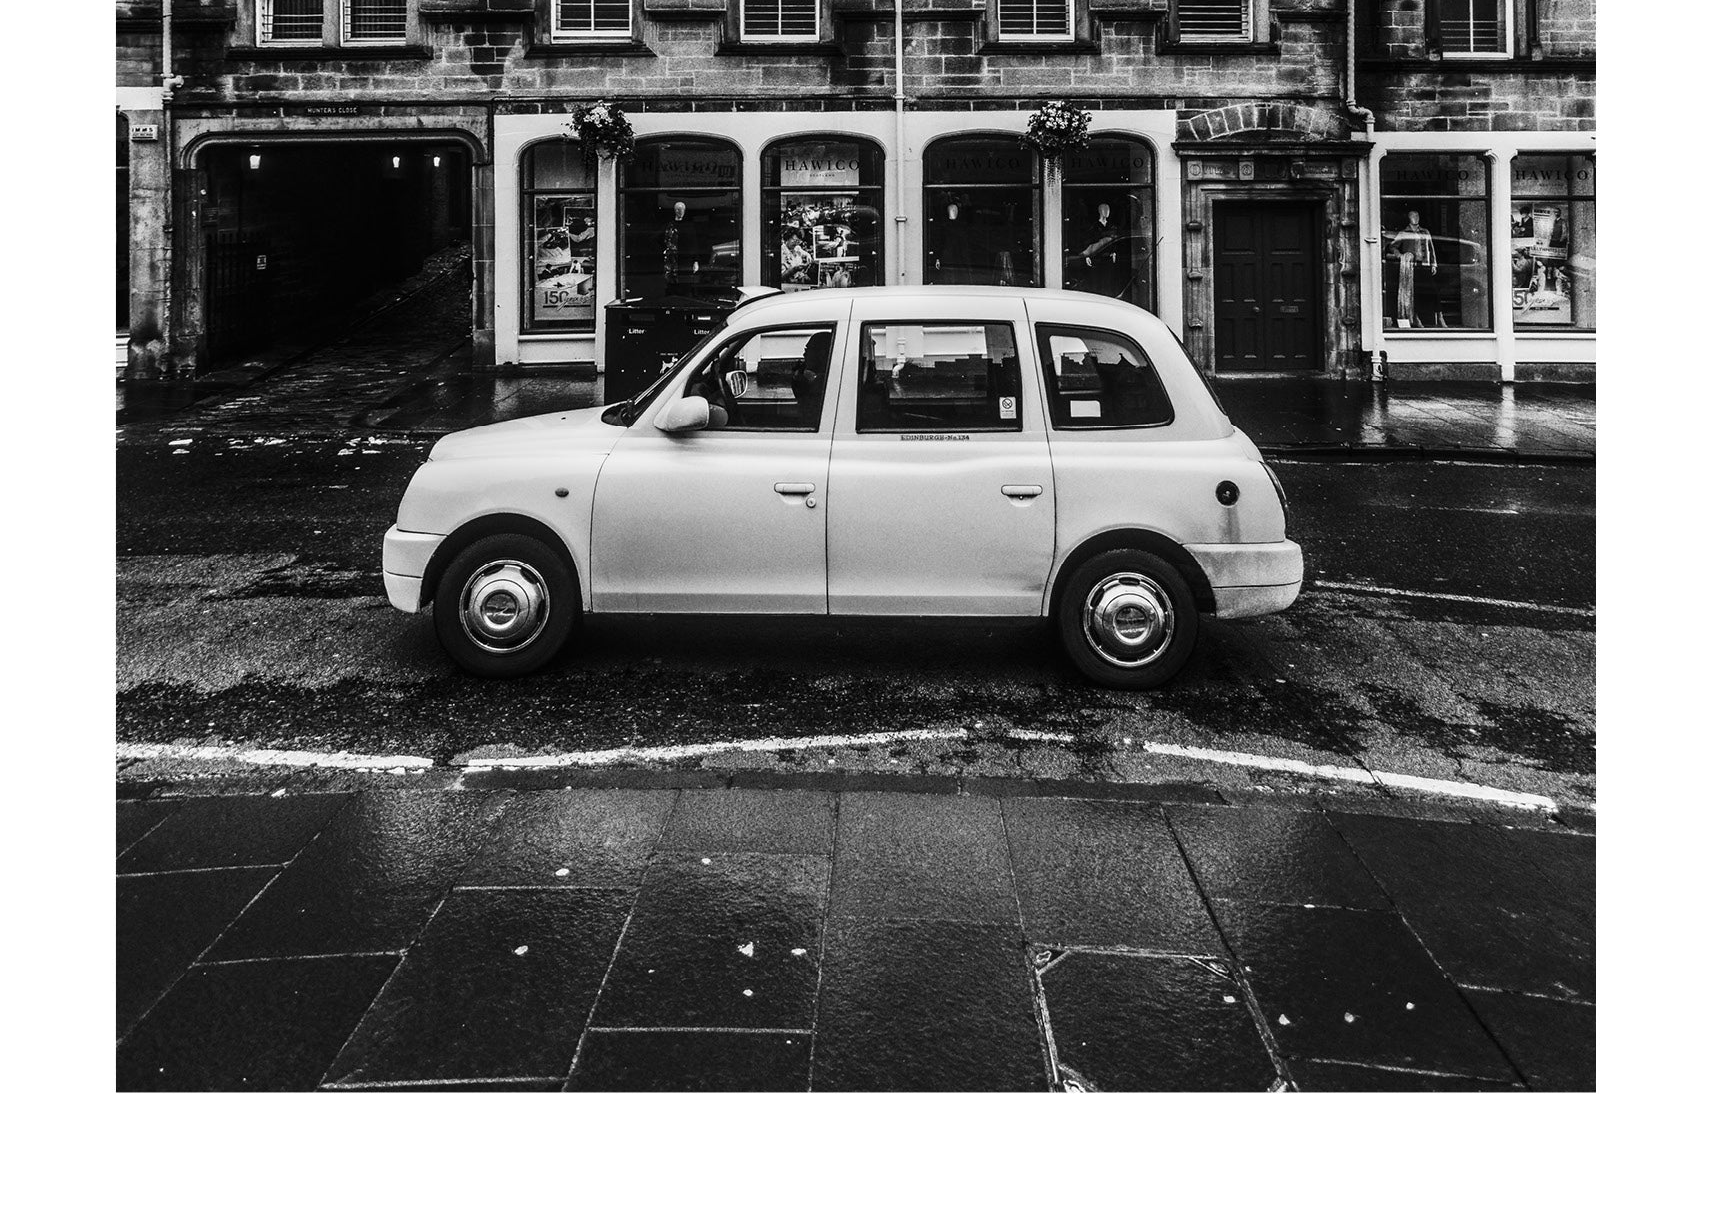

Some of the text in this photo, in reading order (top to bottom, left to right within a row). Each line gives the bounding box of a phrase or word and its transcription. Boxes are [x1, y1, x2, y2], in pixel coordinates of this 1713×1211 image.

[785, 159, 860, 171] HAWICO
[945, 158, 1021, 169] HAWICO
[1071, 157, 1144, 169] HAWICO
[1396, 170, 1469, 181] HAWICO
[1515, 169, 1588, 181] HAWICO
[544, 290, 570, 305] 150
